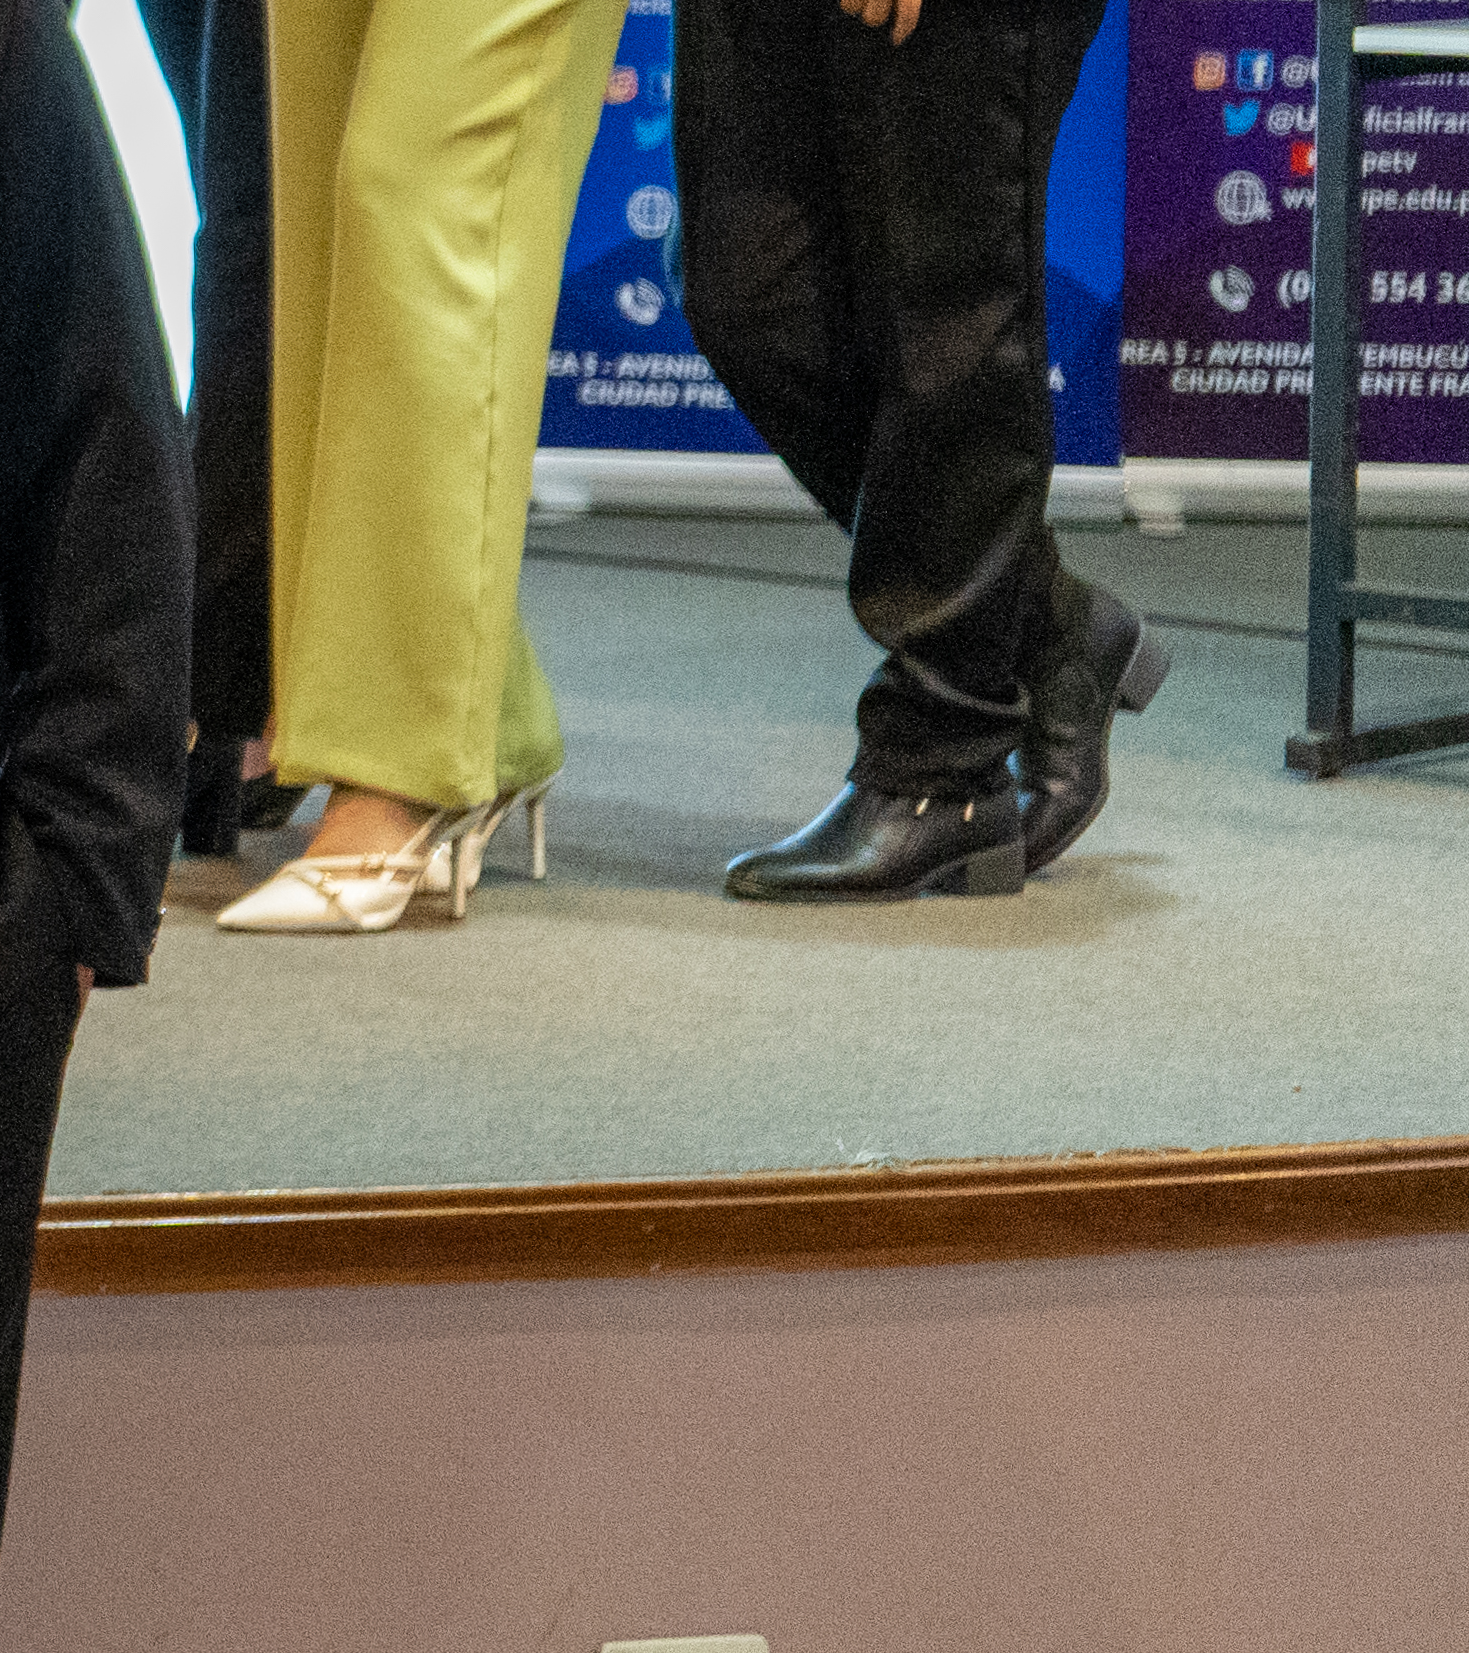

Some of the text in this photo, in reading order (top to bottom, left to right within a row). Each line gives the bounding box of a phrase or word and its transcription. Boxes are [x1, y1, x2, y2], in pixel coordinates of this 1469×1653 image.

[1370, 270, 1427, 304] 554
[1121, 338, 1170, 366] REA
[1173, 339, 1188, 366] 5
[579, 379, 676, 408] CIUDAD
[1171, 367, 1271, 395] CIUDAD
